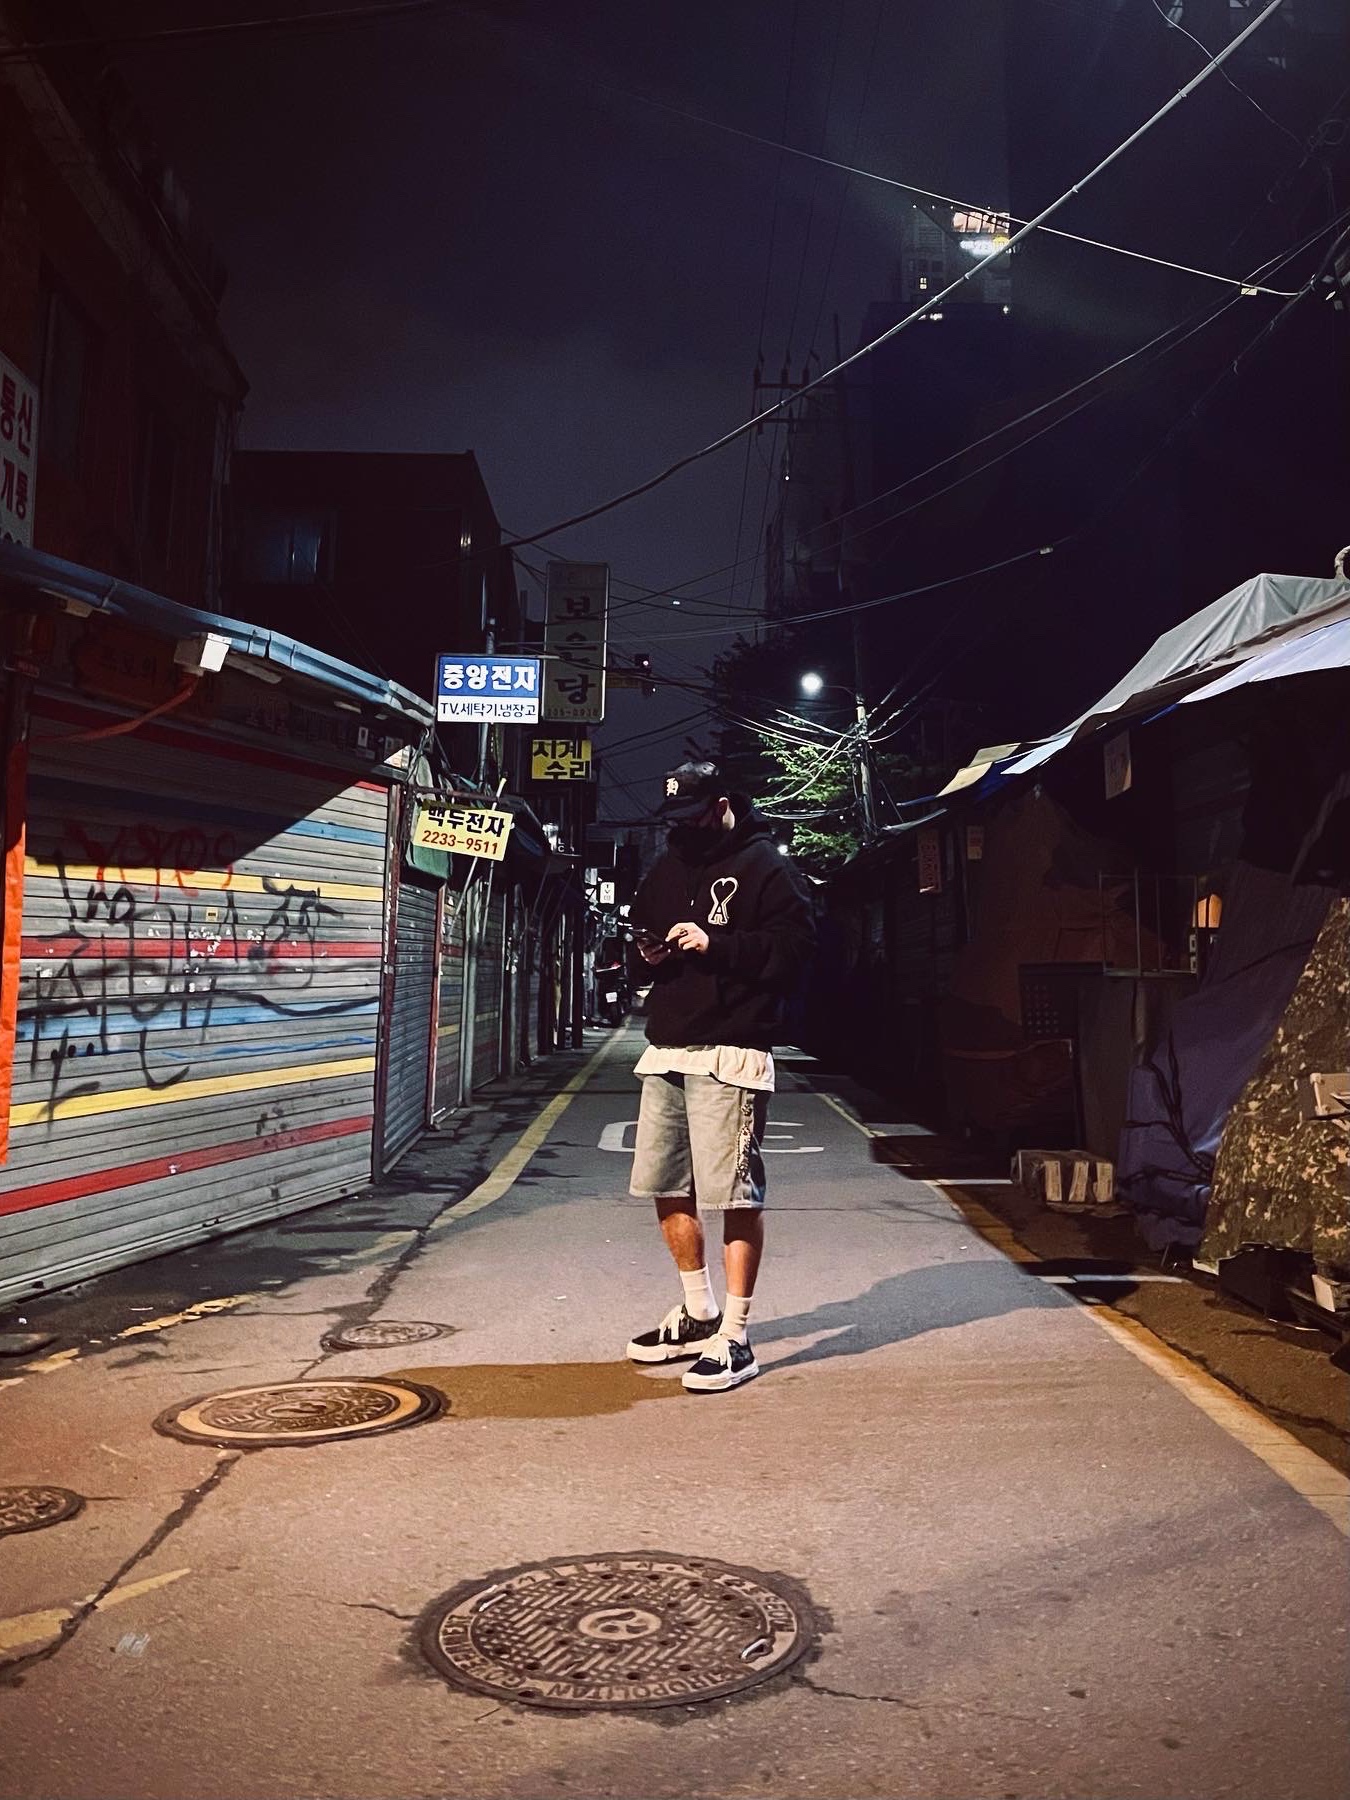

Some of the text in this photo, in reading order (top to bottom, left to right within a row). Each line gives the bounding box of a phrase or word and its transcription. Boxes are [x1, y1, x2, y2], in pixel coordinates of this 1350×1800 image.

[443, 664, 537, 692] 중앙전자
[534, 739, 582, 759] 시계
[545, 760, 591, 780] 수리
[427, 807, 505, 838] 백두전자
[422, 830, 499, 856] 2233-9511
